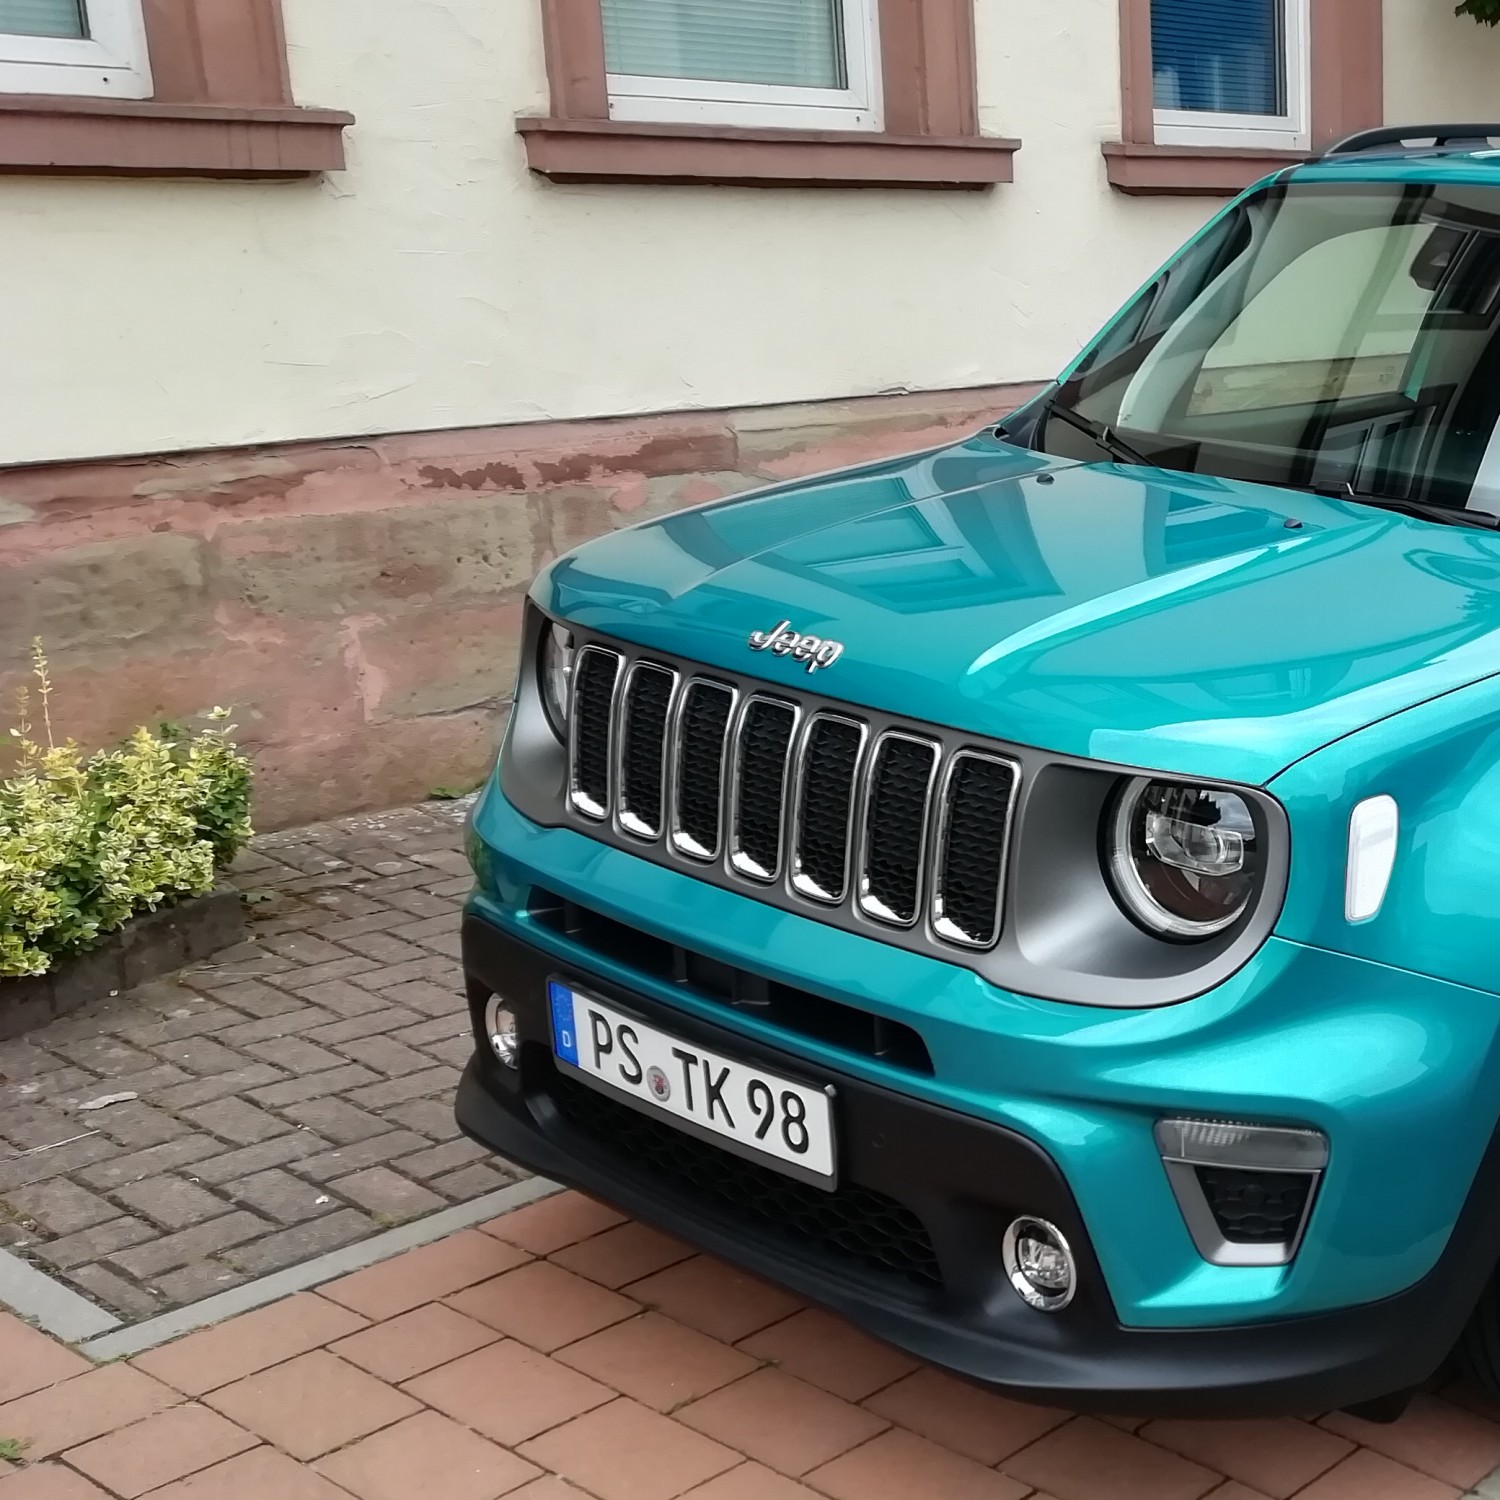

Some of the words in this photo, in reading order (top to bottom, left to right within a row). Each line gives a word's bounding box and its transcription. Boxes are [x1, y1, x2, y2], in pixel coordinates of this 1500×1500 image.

[749, 619, 844, 674] Jeep
[562, 1030, 571, 1048] D
[588, 1009, 643, 1085] PS
[671, 1046, 736, 1129] TK
[746, 1079, 809, 1154] 98
